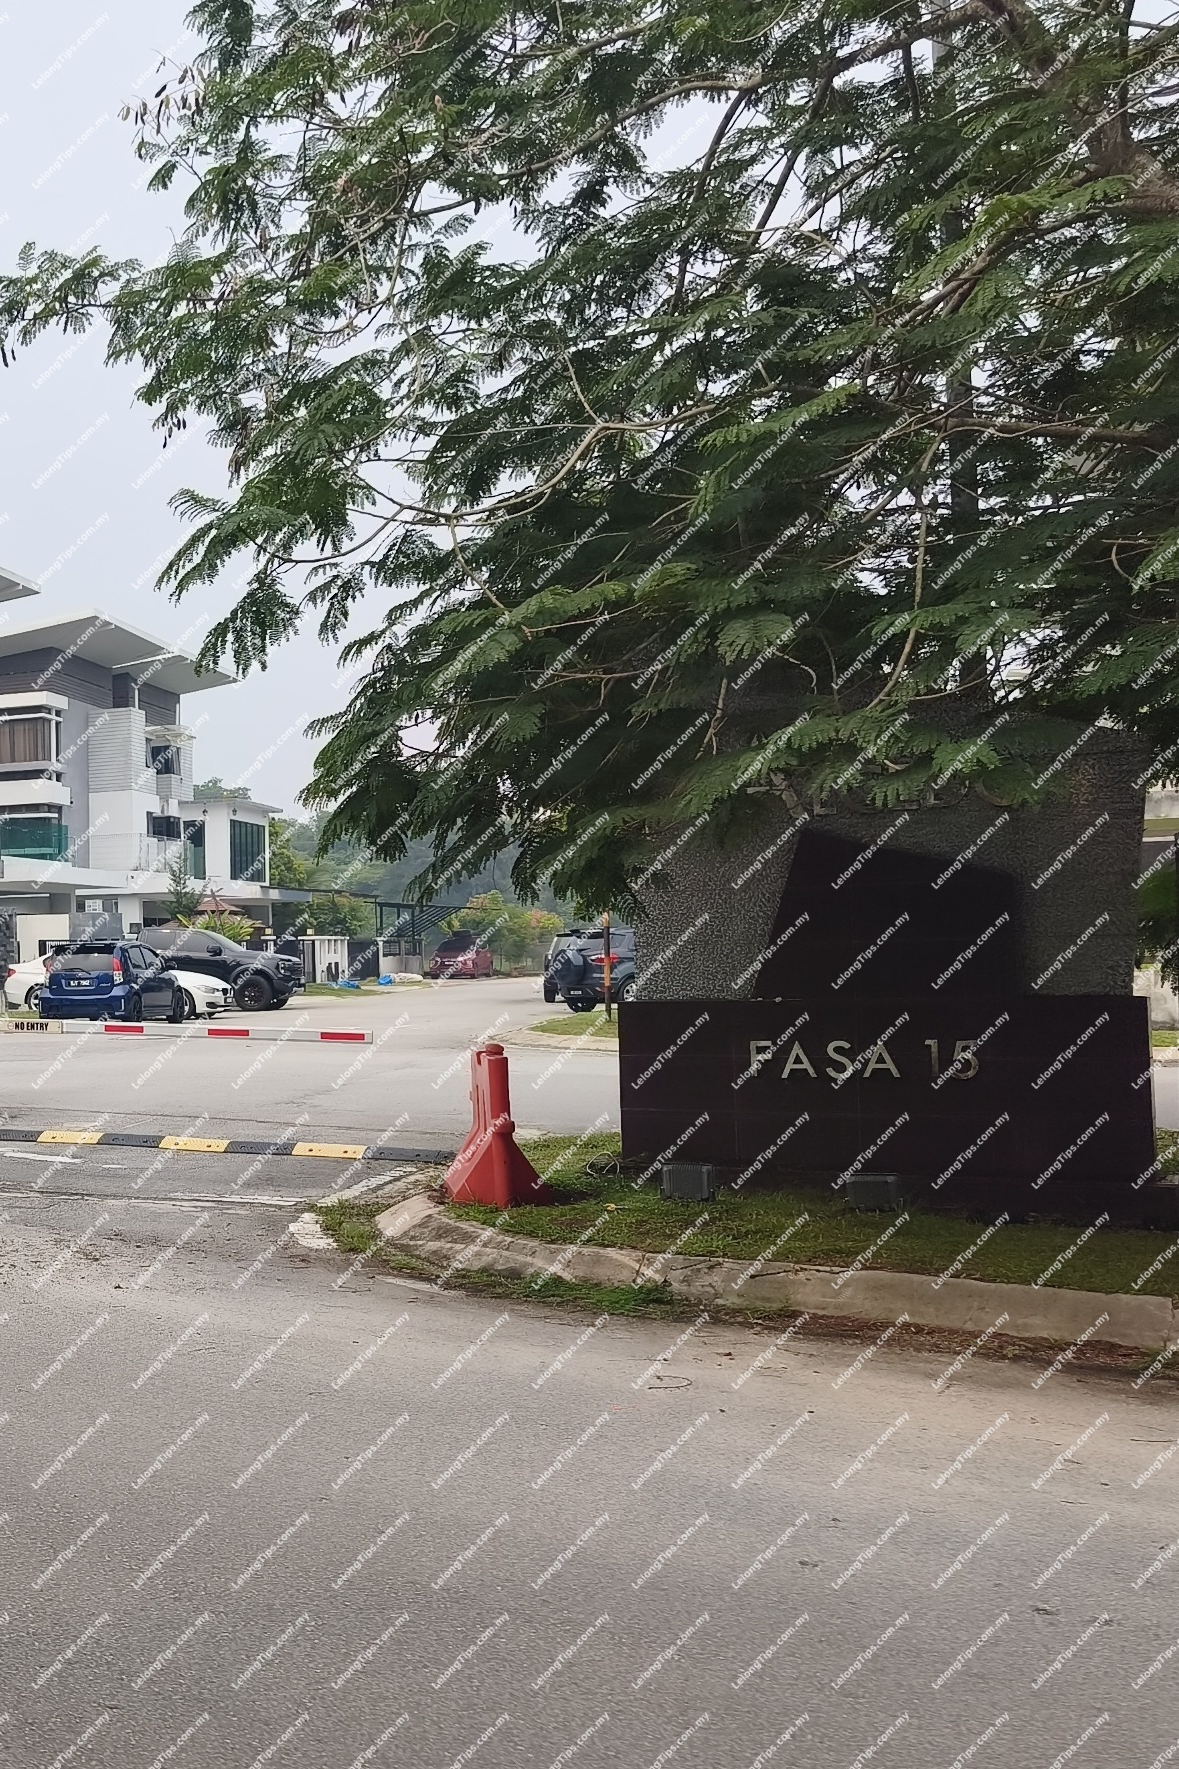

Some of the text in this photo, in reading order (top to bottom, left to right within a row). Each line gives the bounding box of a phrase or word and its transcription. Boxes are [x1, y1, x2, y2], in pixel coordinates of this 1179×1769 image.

[15, 1022, 49, 1031] NO ENTRY
[750, 1039, 980, 1080] FASA 15
